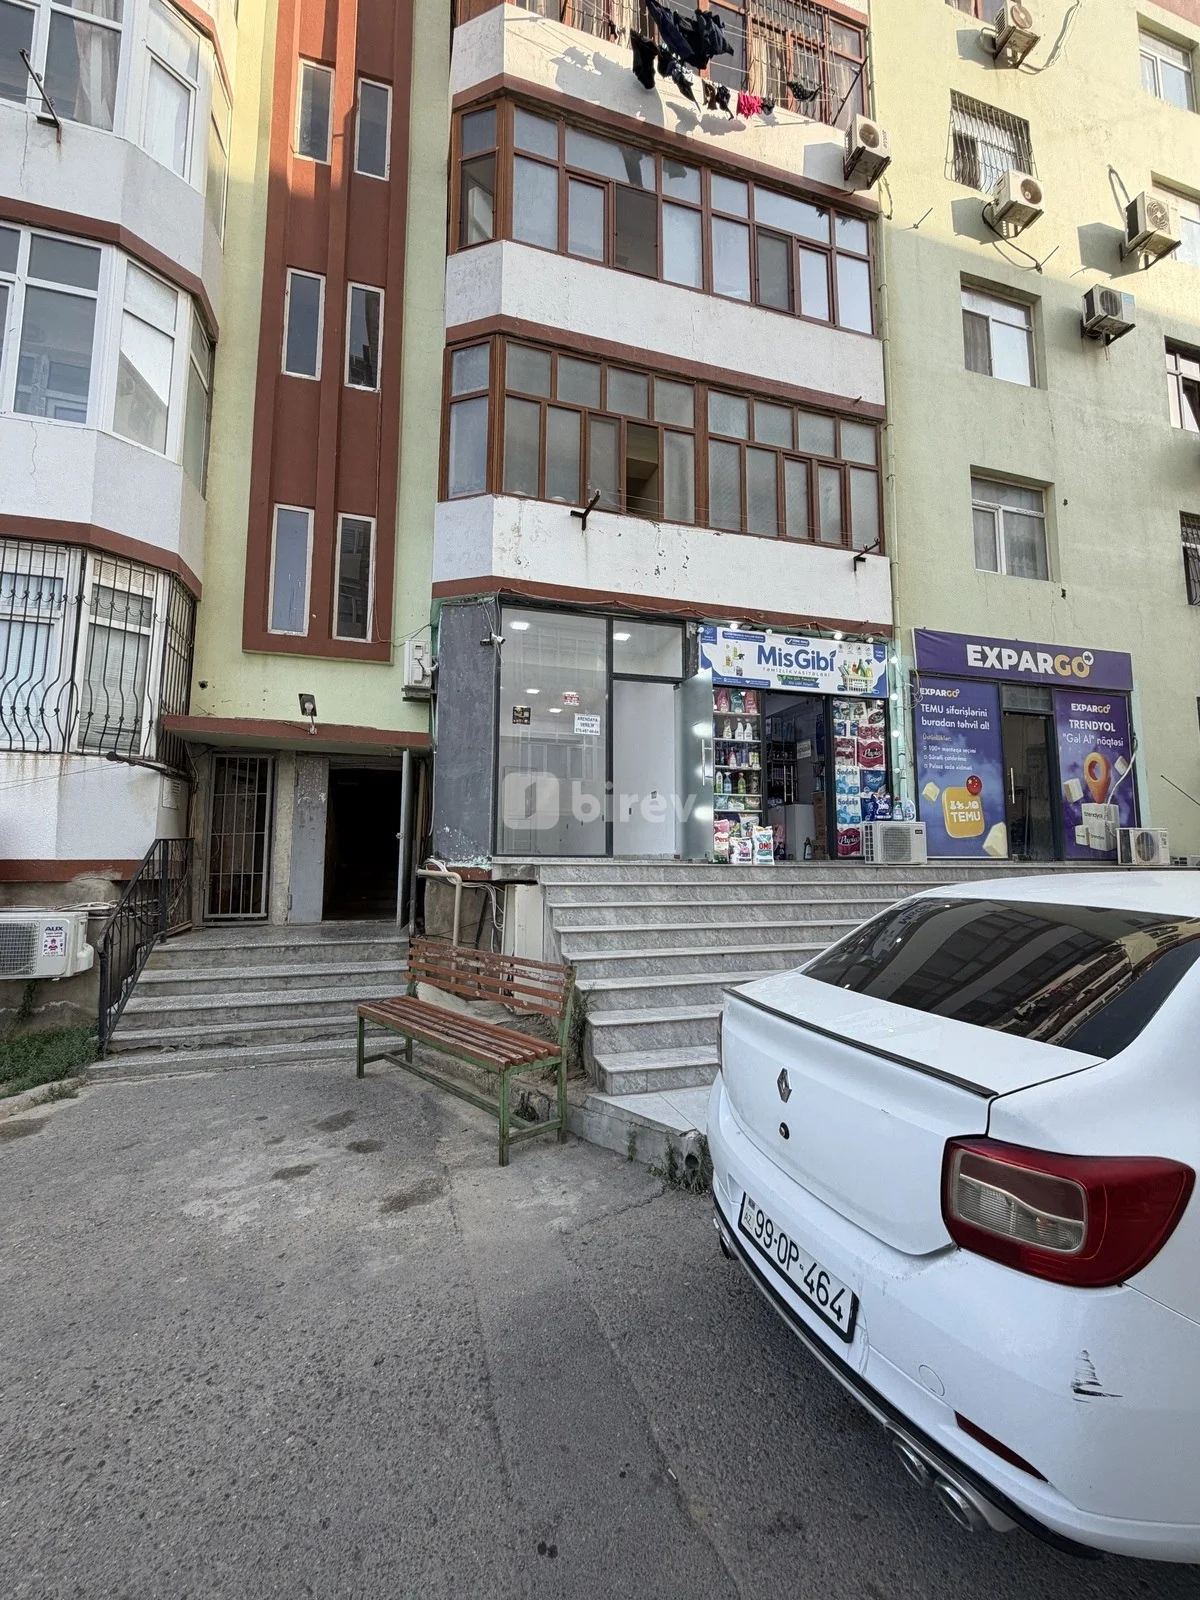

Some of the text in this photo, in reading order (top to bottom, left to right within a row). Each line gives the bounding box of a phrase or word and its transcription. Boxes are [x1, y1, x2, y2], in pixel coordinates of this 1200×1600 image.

[757, 645, 837, 672] MisGibi
[966, 644, 1092, 678] EXPARGO
[919, 688, 959, 698] EXPARGO
[920, 703, 988, 717] TEMU sifarişlərini
[1071, 703, 1110, 714] EXPARGO
[921, 716, 990, 730] buradan təhvil al!
[1069, 719, 1116, 732] TRENDYOL
[1096, 736, 1124, 748] nöqtəsi
[950, 811, 981, 823] TEMU
[754, 1208, 846, 1323] 99-OP-464
